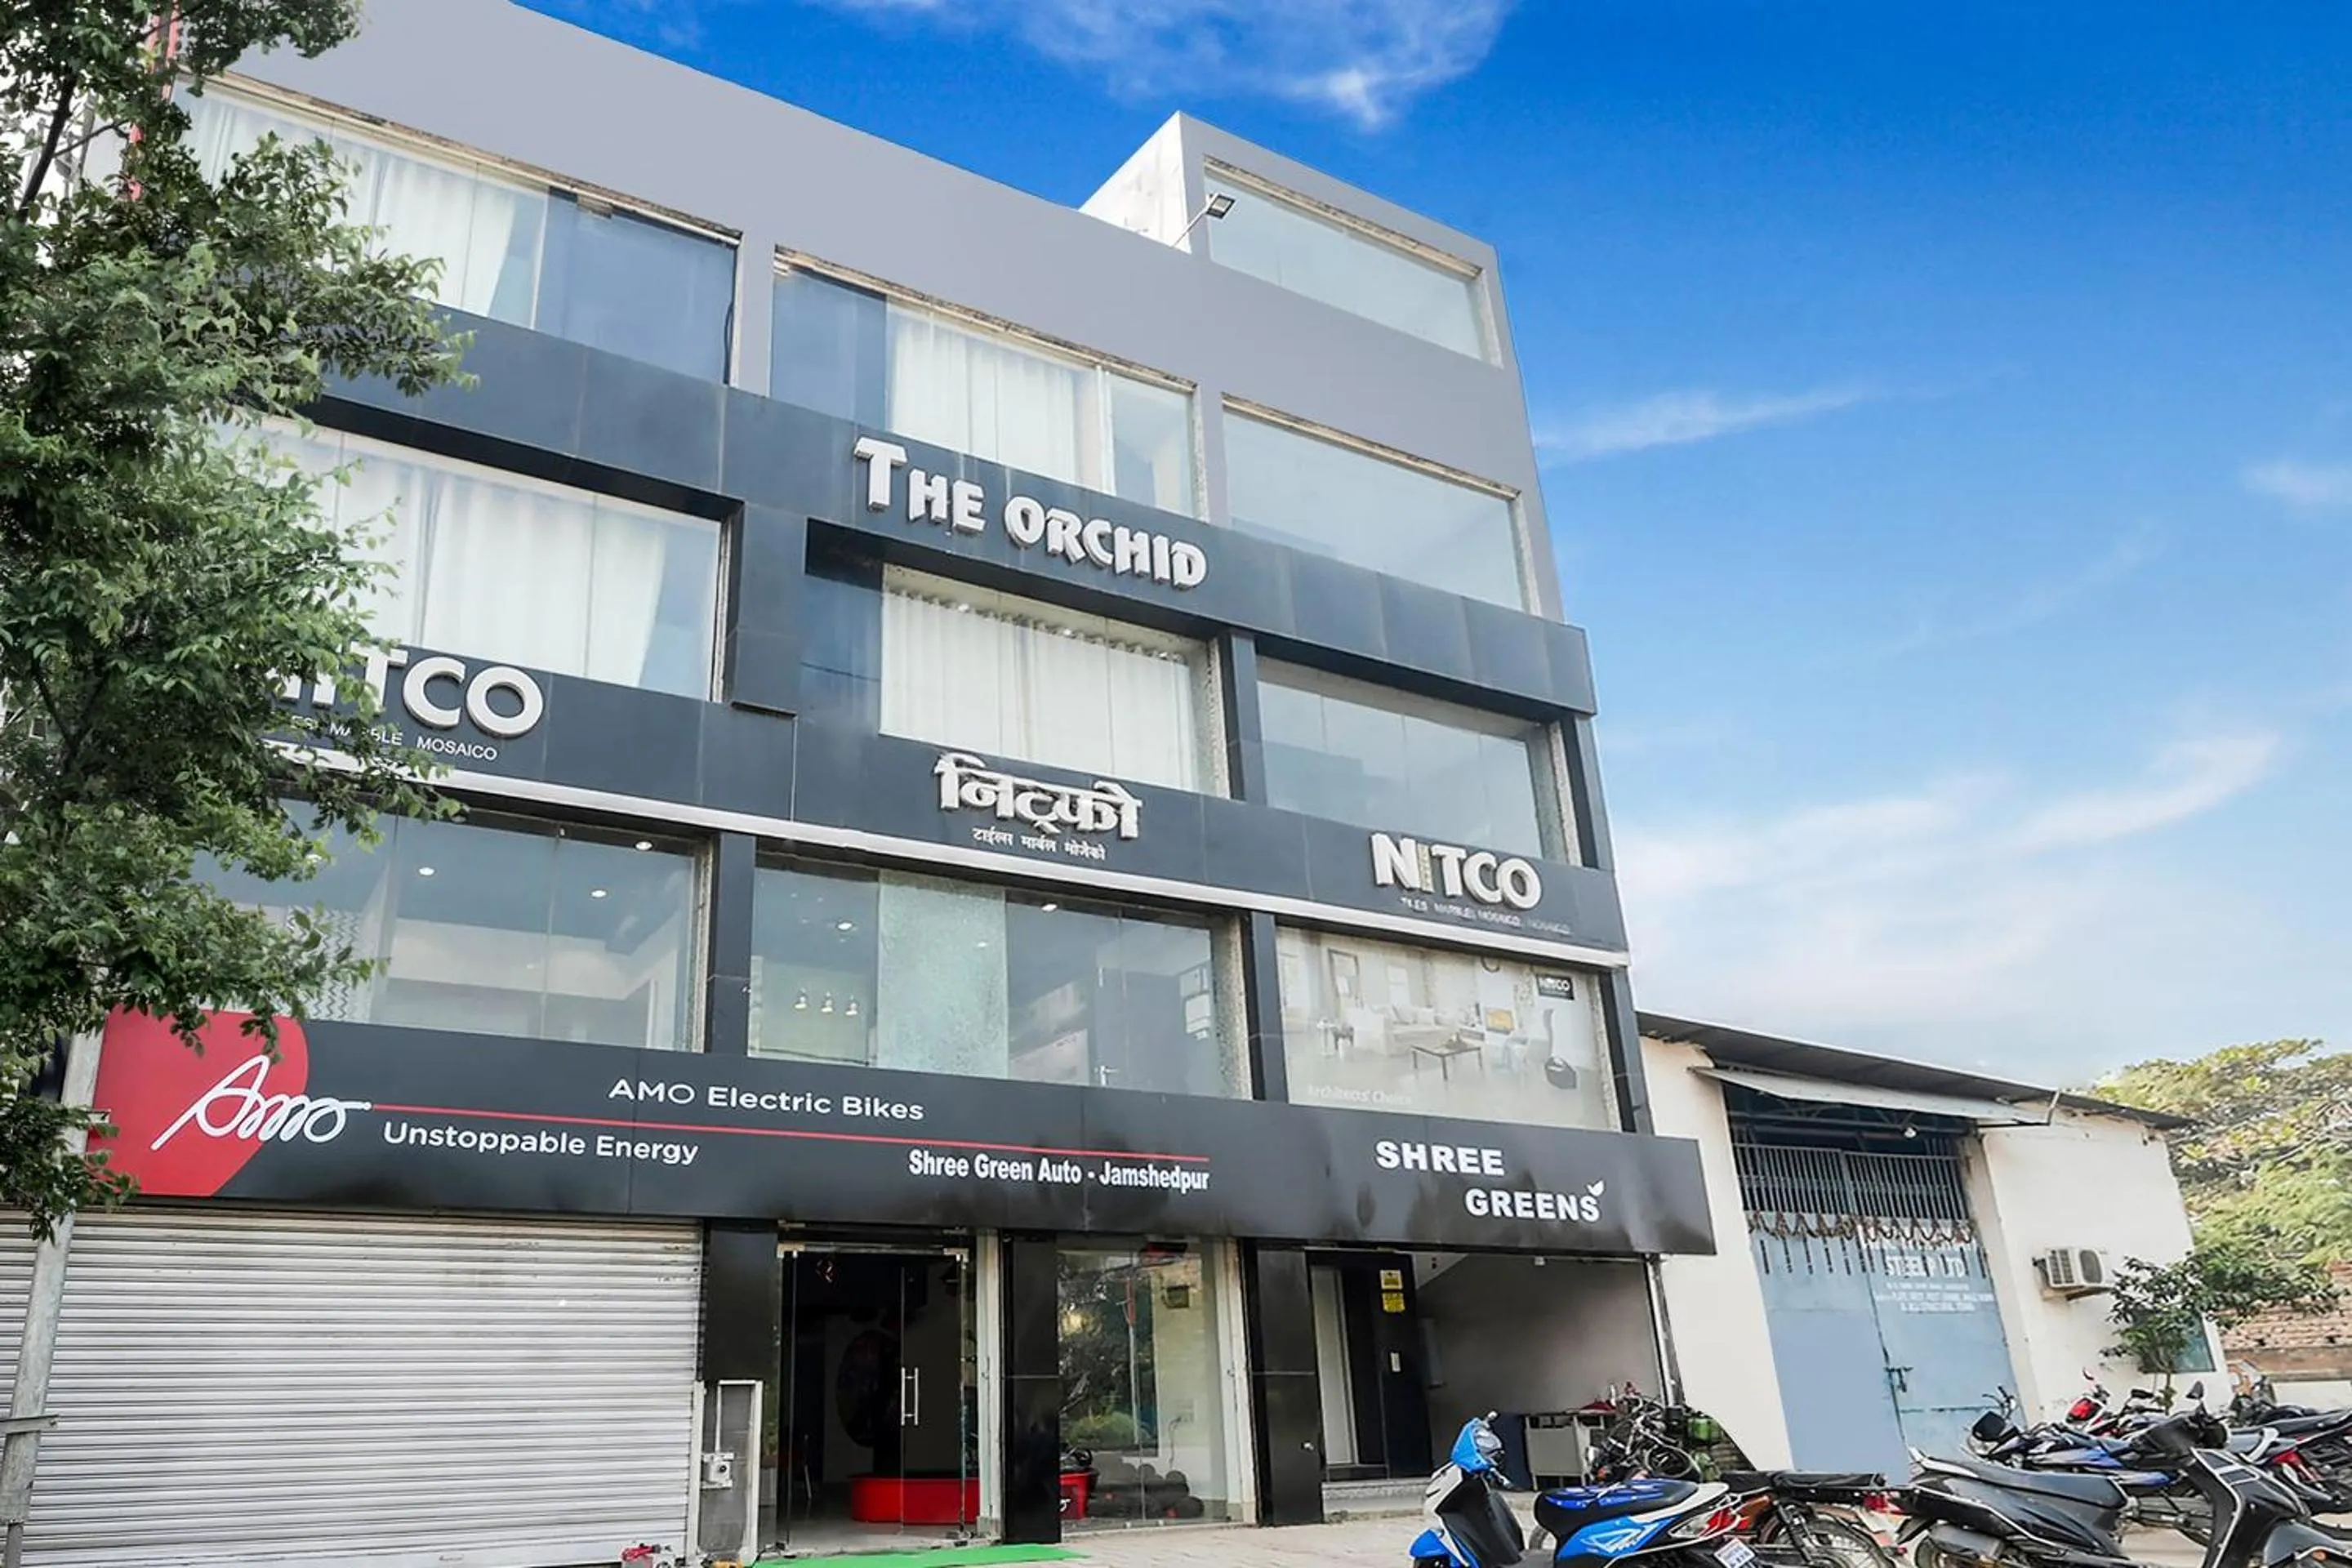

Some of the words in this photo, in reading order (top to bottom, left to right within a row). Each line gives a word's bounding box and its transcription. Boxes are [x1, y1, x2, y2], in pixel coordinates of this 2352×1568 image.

[1004, 495, 1208, 590] ORCHID
[416, 736, 498, 761] MOSAICO
[1370, 832, 1543, 910] NITCO
[608, 1079, 696, 1105] AMO
[707, 1086, 831, 1114] Electric
[842, 1096, 925, 1121] Bikes
[383, 1121, 586, 1156] Unstoppable
[595, 1136, 699, 1165] Energy
[1375, 1141, 1505, 1176] SHREE
[908, 1149, 969, 1177] Shree
[974, 1153, 1033, 1182] Green
[1037, 1157, 1082, 1184] Auto
[1098, 1161, 1209, 1194] Jamshedpur
[1465, 1188, 1601, 1223] GREENS
